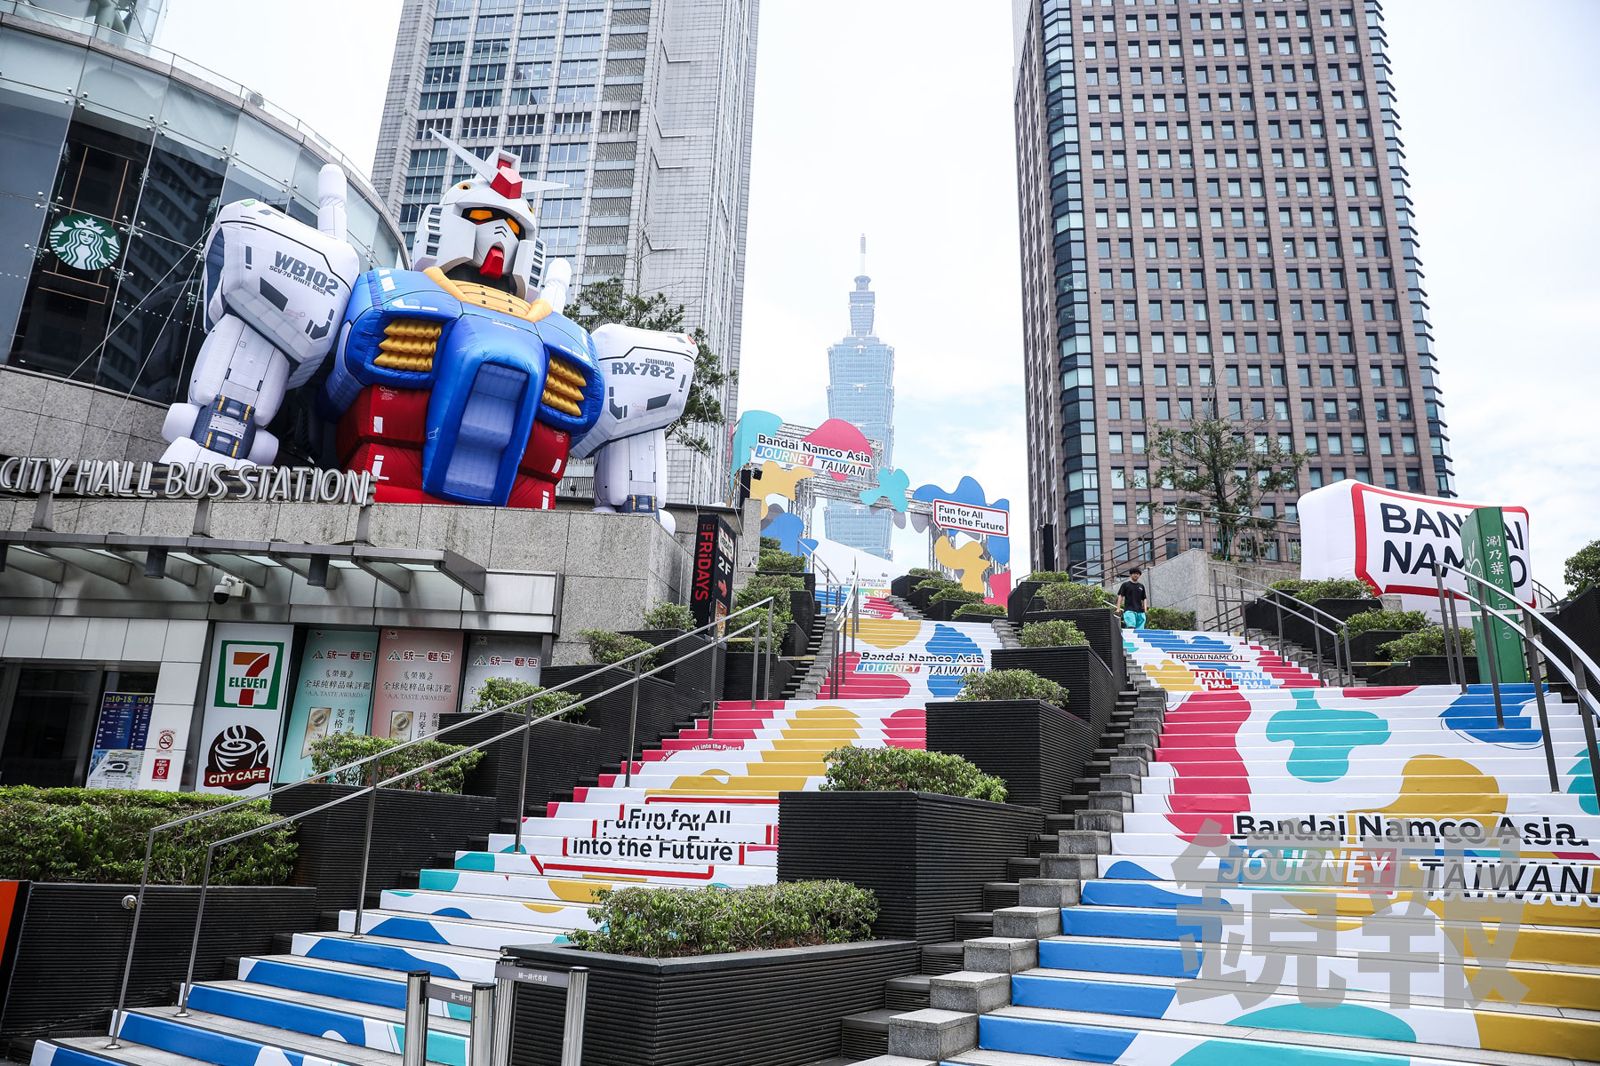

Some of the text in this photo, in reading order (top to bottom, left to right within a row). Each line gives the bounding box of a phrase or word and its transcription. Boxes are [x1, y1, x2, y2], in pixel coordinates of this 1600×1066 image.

[275, 250, 339, 296] WB102
[611, 362, 675, 380] RX-78-2
[645, 358, 675, 367] GUNDAM
[757, 447, 866, 476] JOURNEY TAIWAN
[758, 434, 870, 463] Bandai Namco Asia
[0, 456, 372, 507] CITY HALL BUS STATION
[939, 505, 984, 519] Fun for All
[939, 514, 1005, 532] into the Future
[1380, 502, 1525, 551] BANAI
[717, 556, 732, 576] 2F
[1382, 540, 1527, 588] NAMO
[861, 652, 984, 663] Bandai Namco Asia
[862, 663, 980, 675] JOURNEY TAIWAN
[208, 769, 266, 784] CITY CAFE
[1230, 814, 1590, 847] Bandai Namco Asia
[573, 836, 733, 862] into the Future
[1222, 848, 1600, 904] JOURNEY TAIWAN
